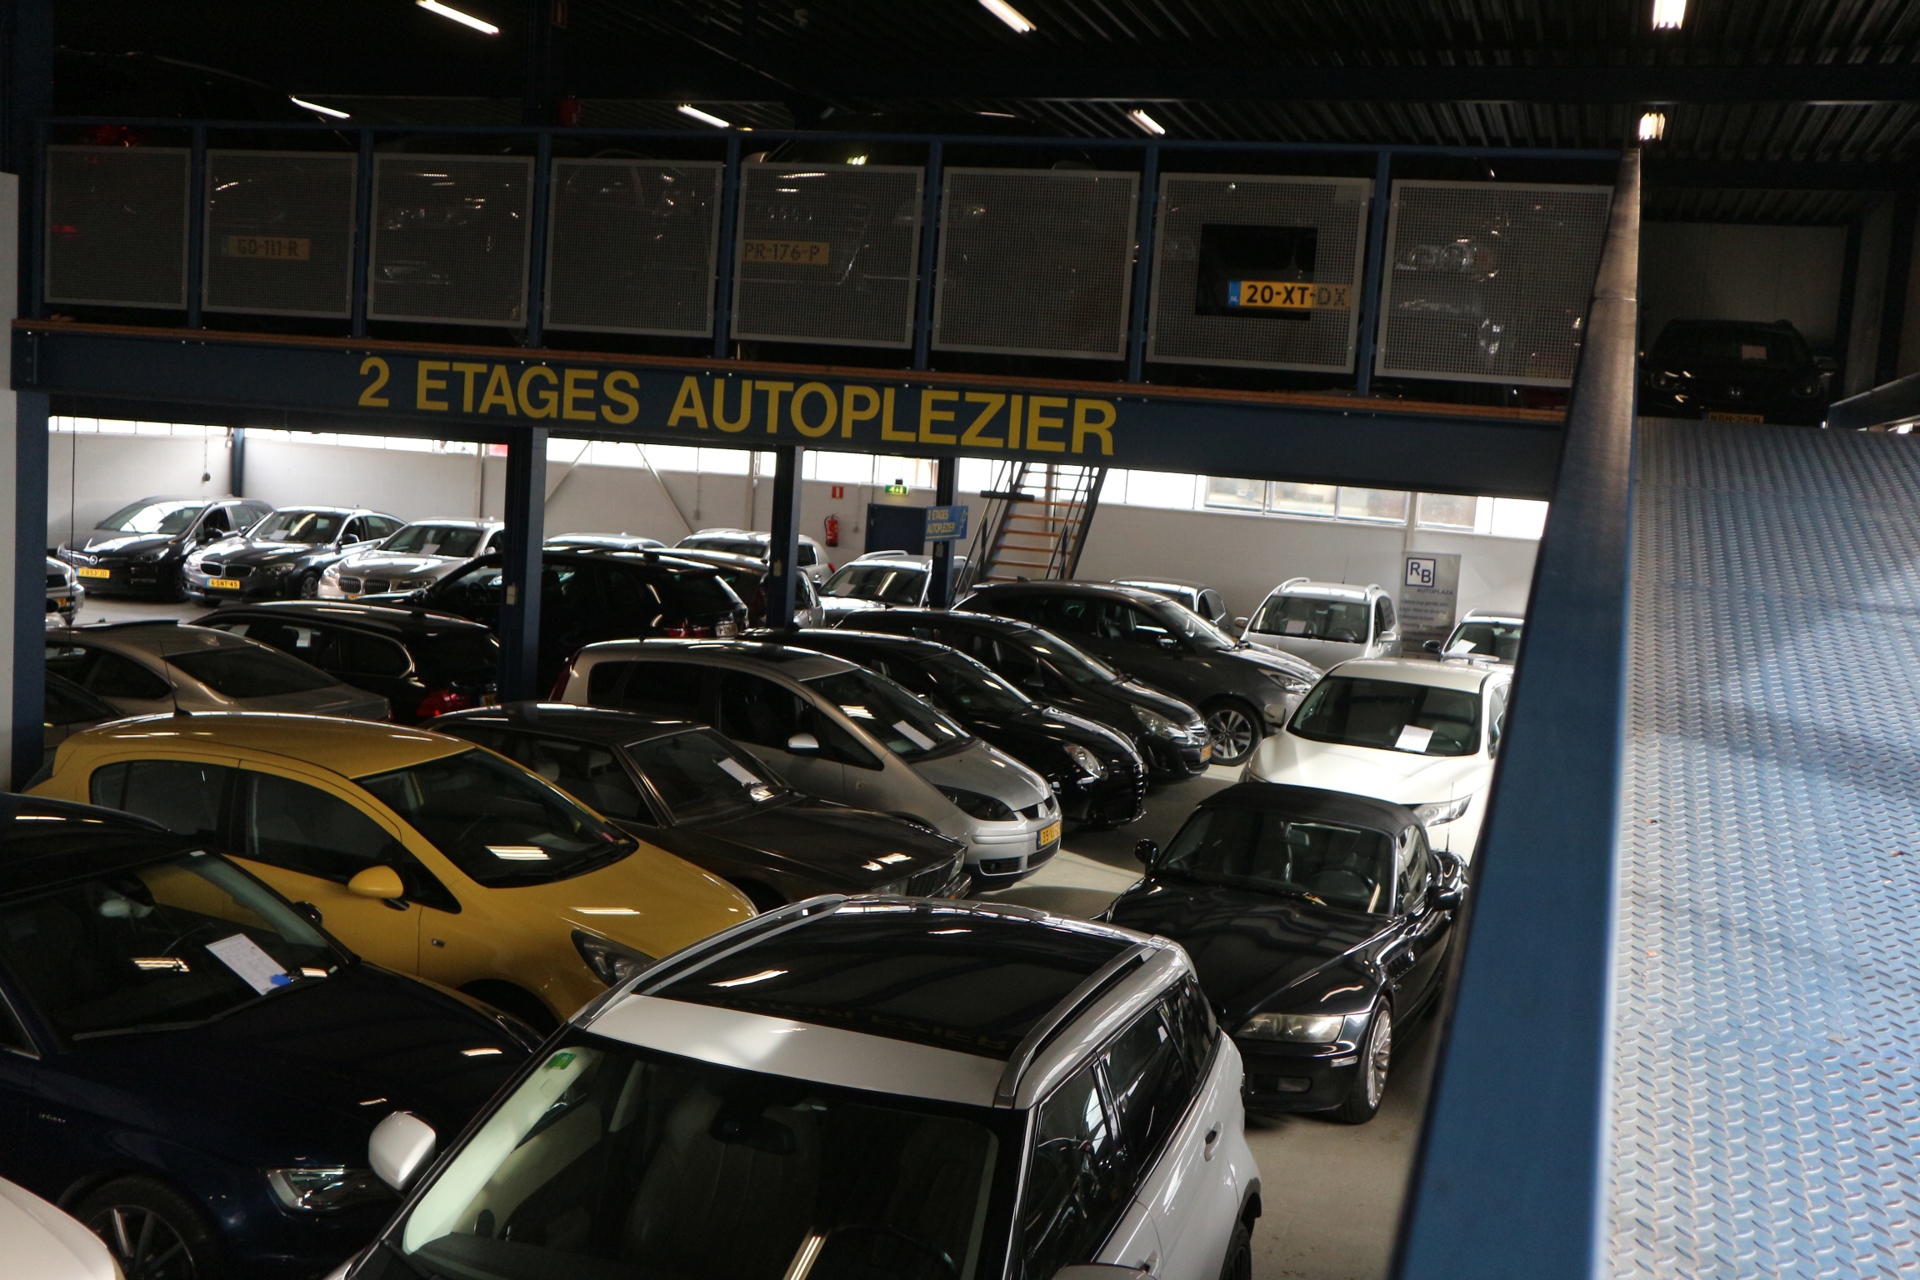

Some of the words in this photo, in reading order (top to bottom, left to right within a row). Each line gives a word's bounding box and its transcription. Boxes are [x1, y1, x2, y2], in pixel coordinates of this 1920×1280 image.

[744, 242, 820, 261] PR-176-P
[1246, 284, 1346, 306] 20-XT-DX
[358, 356, 390, 407] 2
[416, 359, 640, 425] ETAGES
[666, 375, 1118, 456] AUTOPLEZIER
[1416, 588, 1454, 596] AUTOPLAZA
